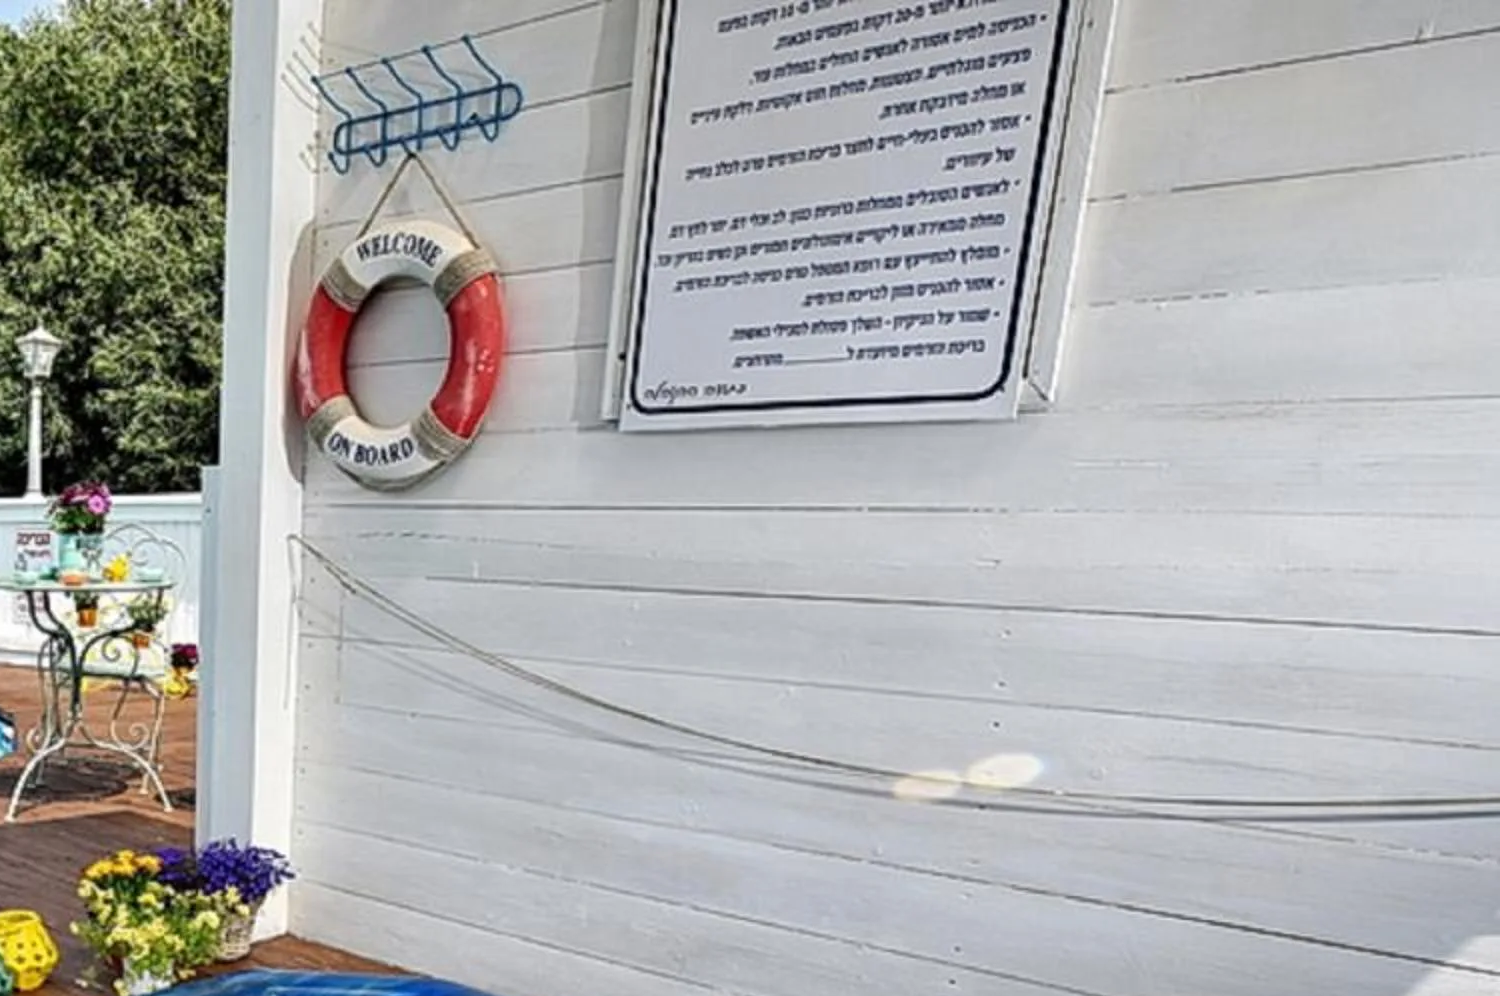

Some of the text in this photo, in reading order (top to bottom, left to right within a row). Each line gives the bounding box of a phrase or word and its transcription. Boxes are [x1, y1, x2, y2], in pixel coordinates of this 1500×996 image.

[952, 21, 986, 43] למים
[1010, 81, 1026, 97] או
[939, 118, 986, 140] להכניס
[989, 114, 1021, 132] אסור
[995, 147, 1016, 162] של
[960, 178, 1011, 200] לאנשים
[901, 224, 916, 238] או
[356, 232, 443, 268] WELCOME
[883, 256, 903, 270] עם
[917, 278, 962, 297] להכניס
[963, 277, 996, 291] אסור
[937, 310, 955, 325] על
[958, 308, 991, 322] שמור
[327, 432, 414, 466] ON BOARD
